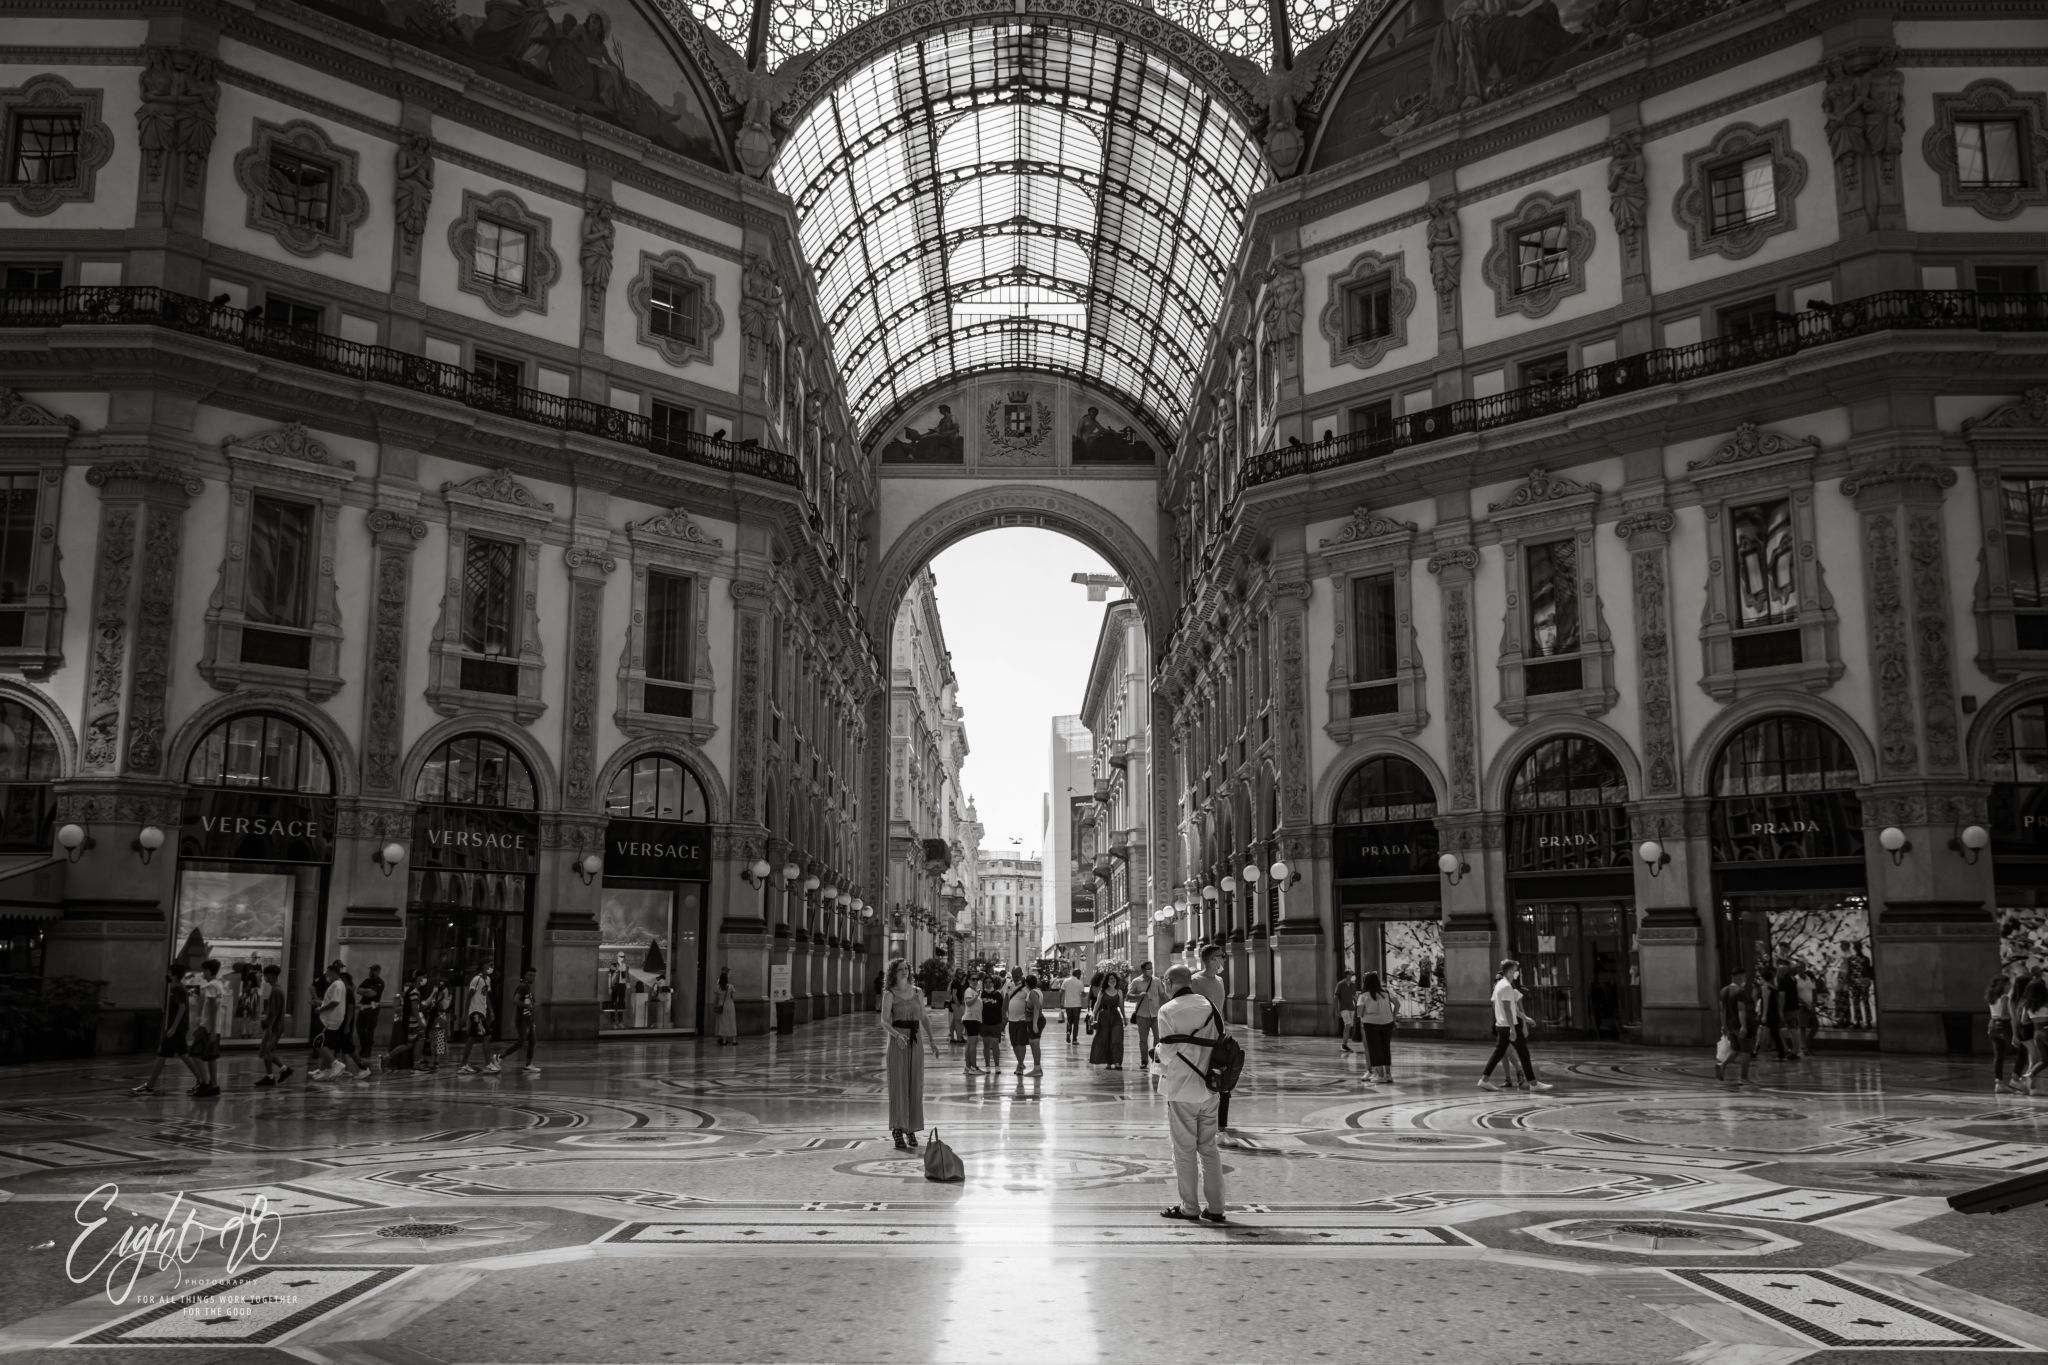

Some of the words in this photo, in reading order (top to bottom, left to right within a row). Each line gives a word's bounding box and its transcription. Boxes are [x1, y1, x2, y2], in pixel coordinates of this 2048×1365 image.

[200, 815, 319, 838] VERSACE
[1751, 819, 1821, 836] PRADA
[427, 829, 527, 850] VERSACE
[1539, 833, 1598, 848] PRADA
[616, 840, 700, 860] VERSACE
[1361, 844, 1412, 857] PRADA
